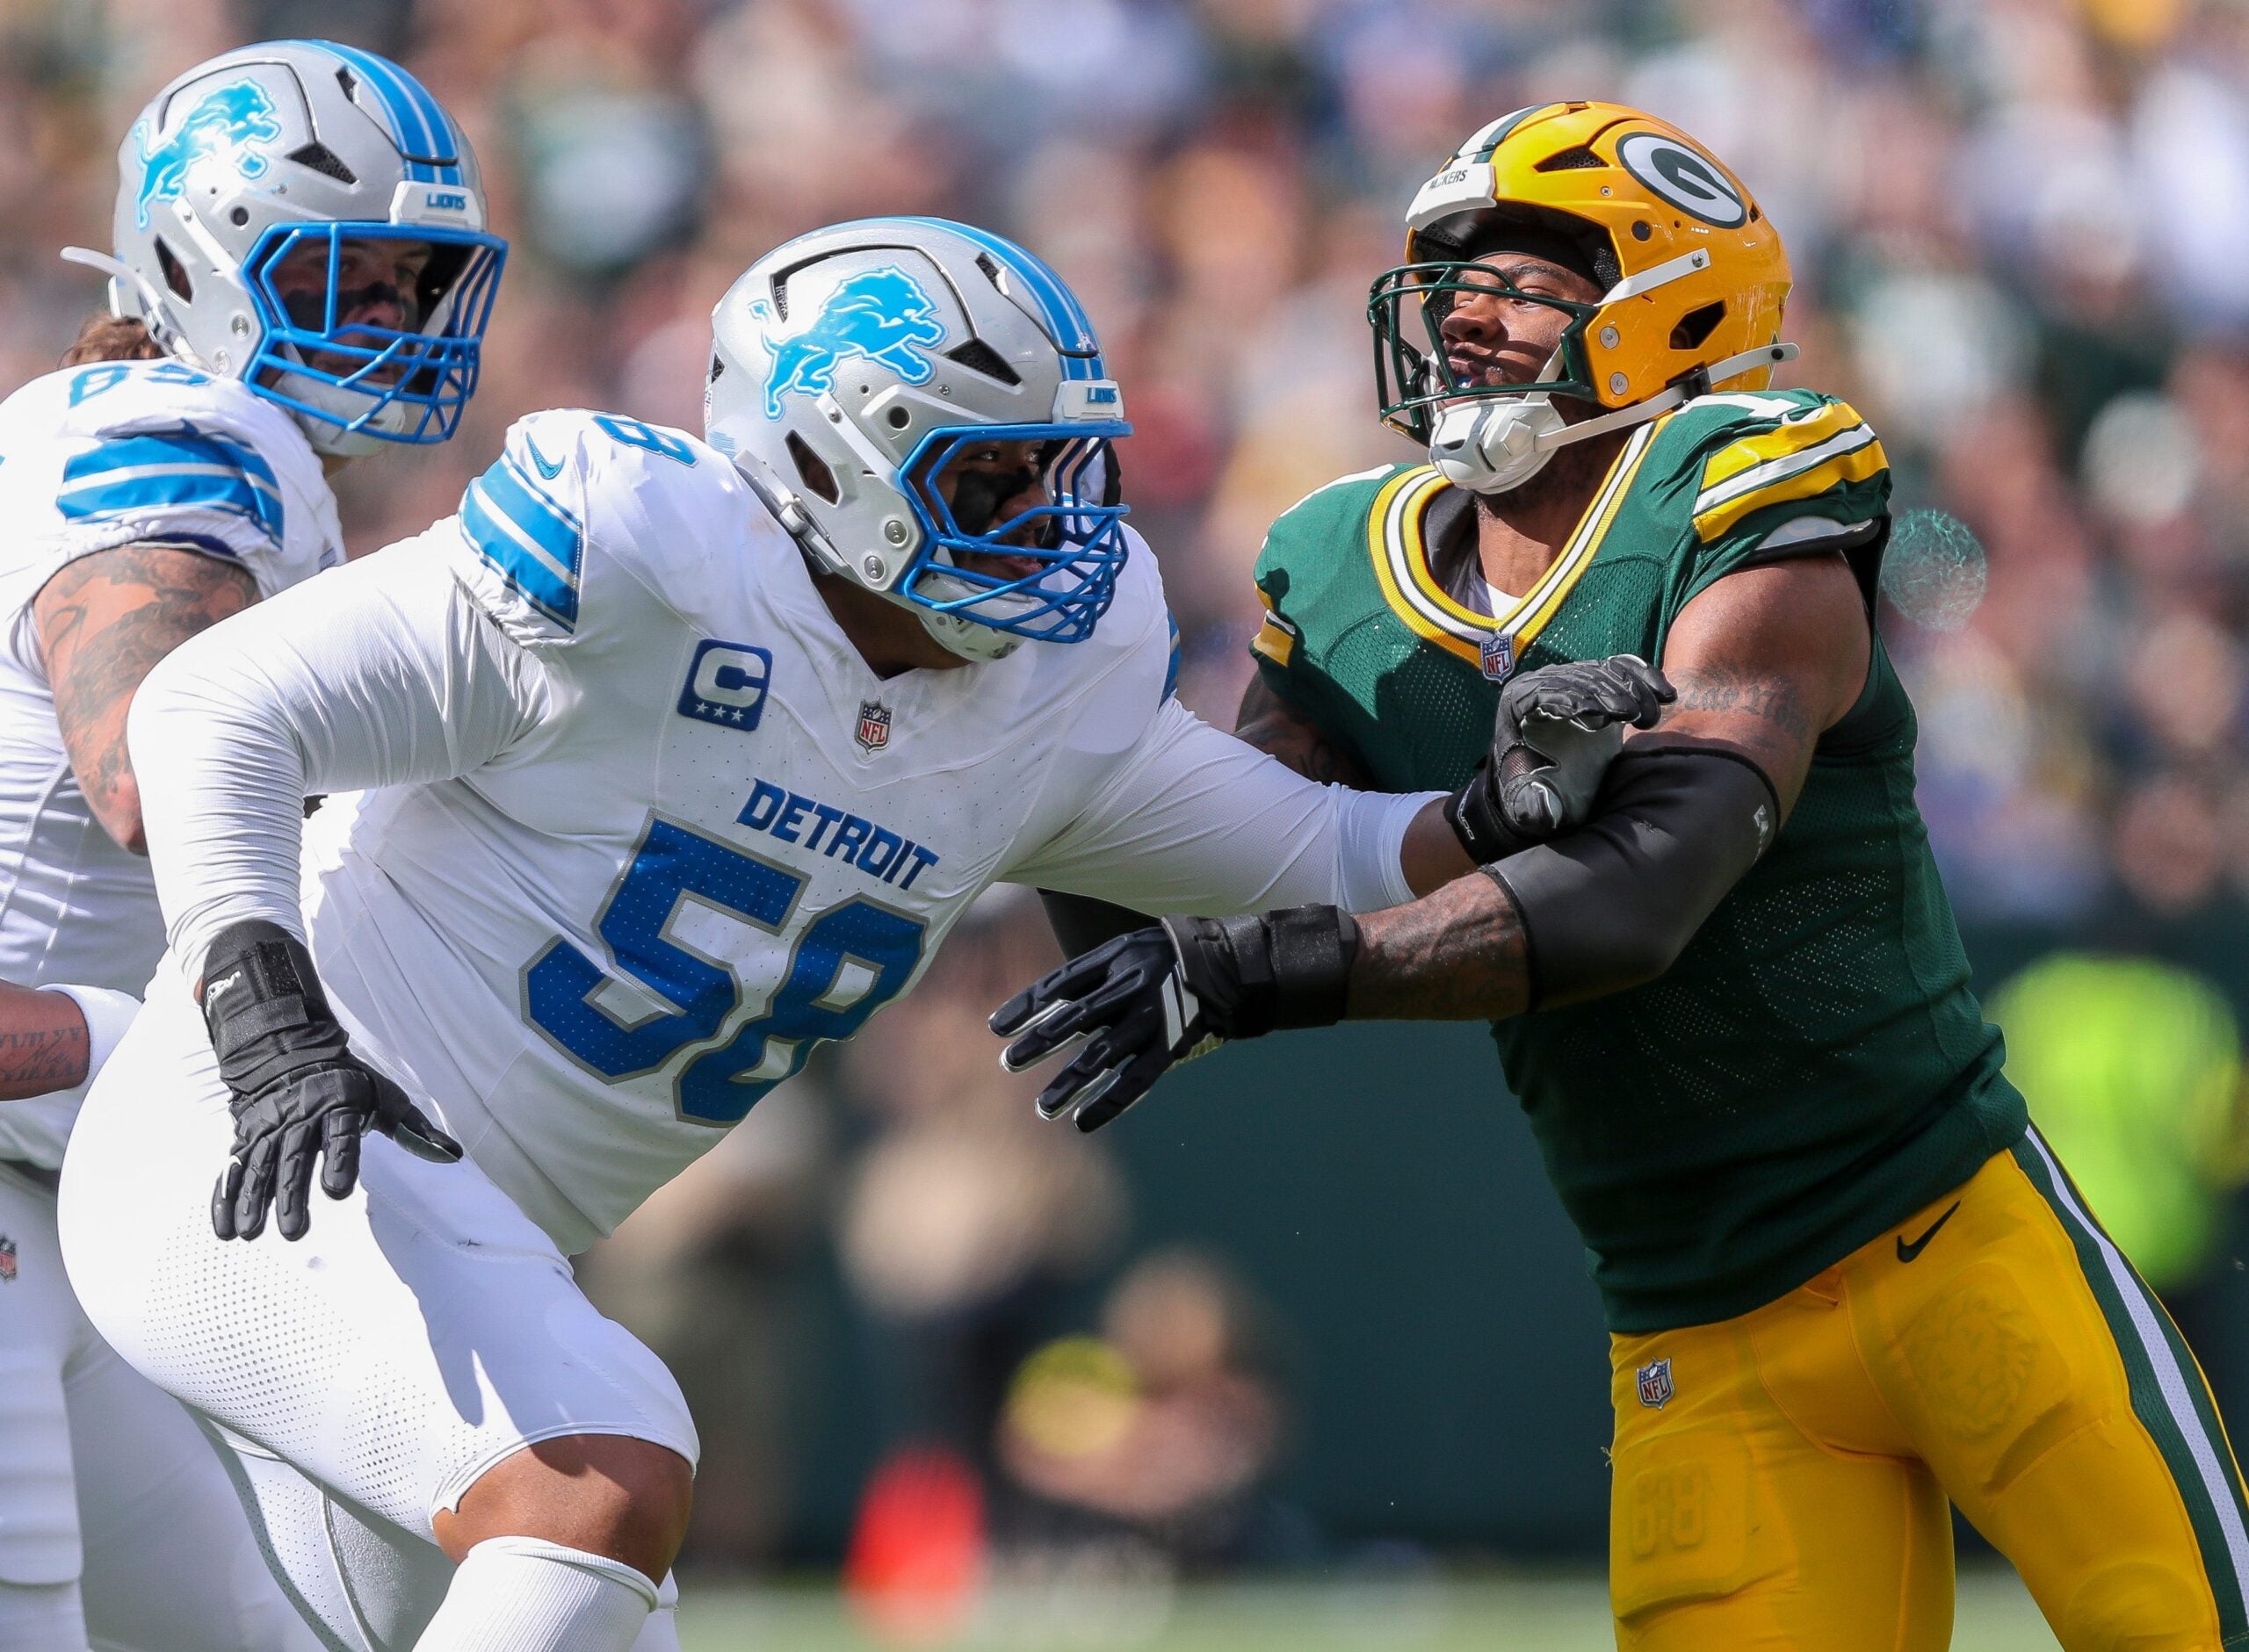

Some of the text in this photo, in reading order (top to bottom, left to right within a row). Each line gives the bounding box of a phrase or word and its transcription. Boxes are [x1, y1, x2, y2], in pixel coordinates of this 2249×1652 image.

[426, 192, 466, 211] LIONS
[1087, 386, 1117, 404] LIONS
[1486, 653, 1510, 675] NFL
[693, 646, 766, 709] C
[861, 719, 886, 744] NFL
[736, 777, 940, 891] DETROIT
[518, 808, 930, 1129] 58
[1642, 1376, 1668, 1400] NFL
